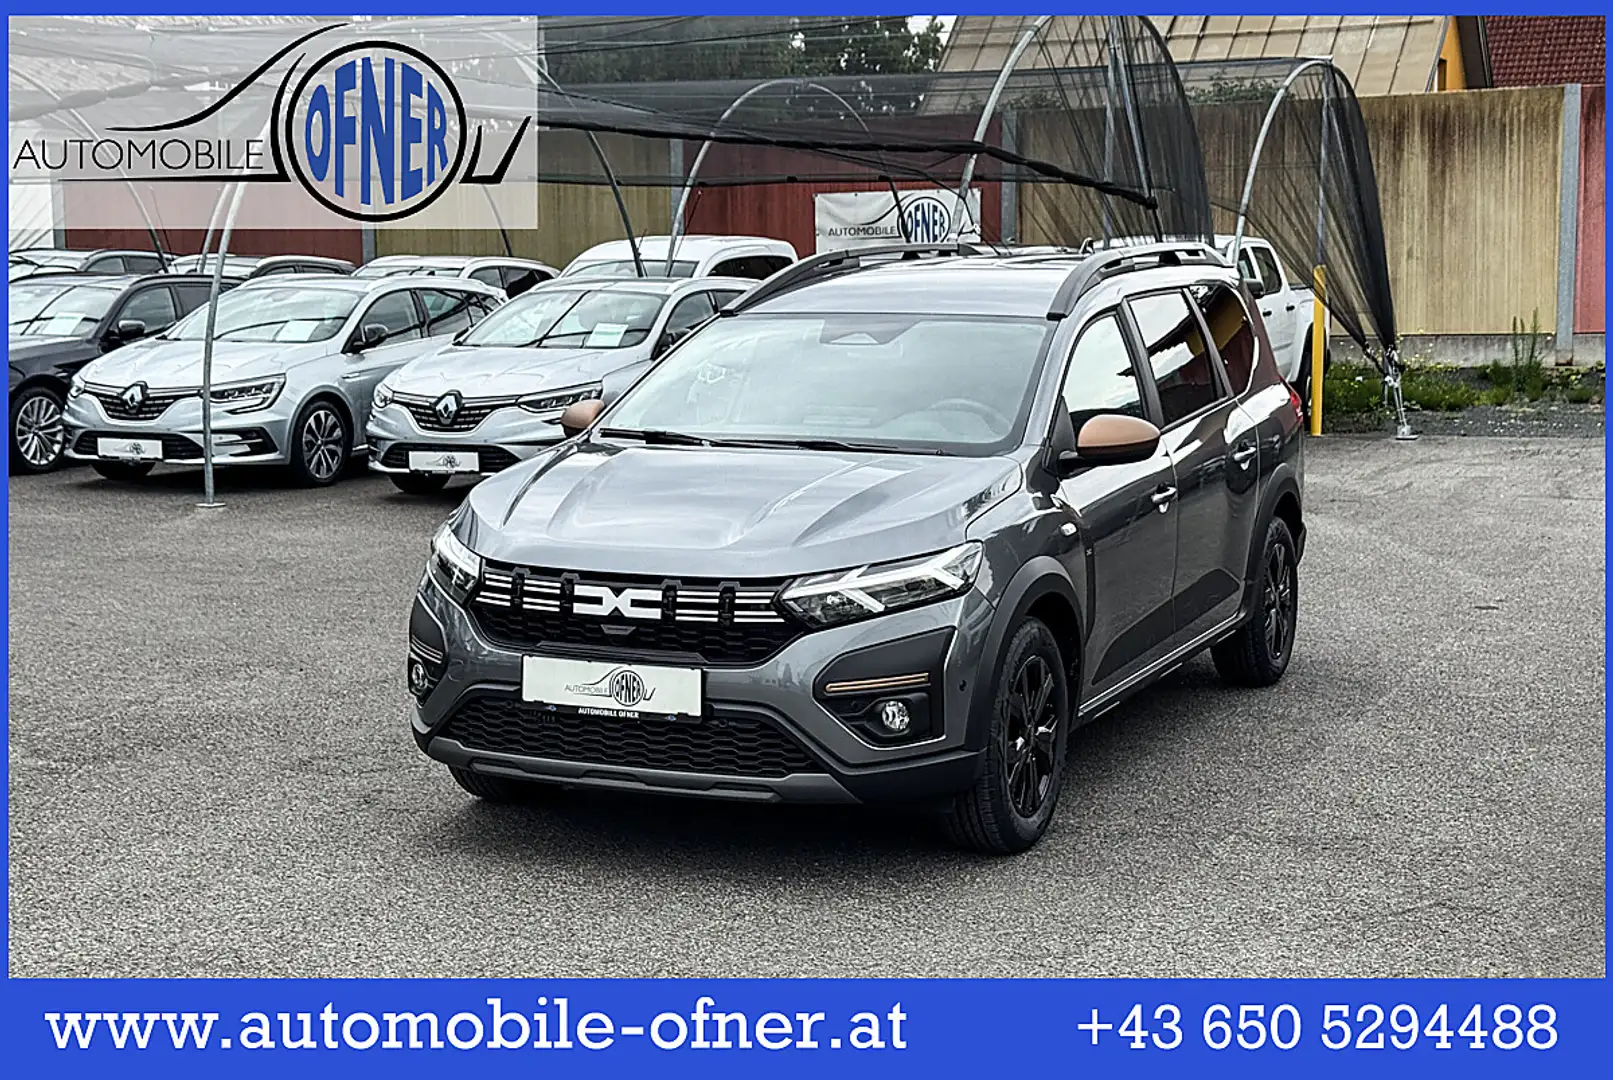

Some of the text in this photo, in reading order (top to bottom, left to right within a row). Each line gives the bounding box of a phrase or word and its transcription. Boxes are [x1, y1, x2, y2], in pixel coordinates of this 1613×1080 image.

[828, 202, 946, 243] AUTOMOBILE OFNER
[615, 673, 641, 703] OFNER
[578, 707, 617, 716] AUTOMOBILE
